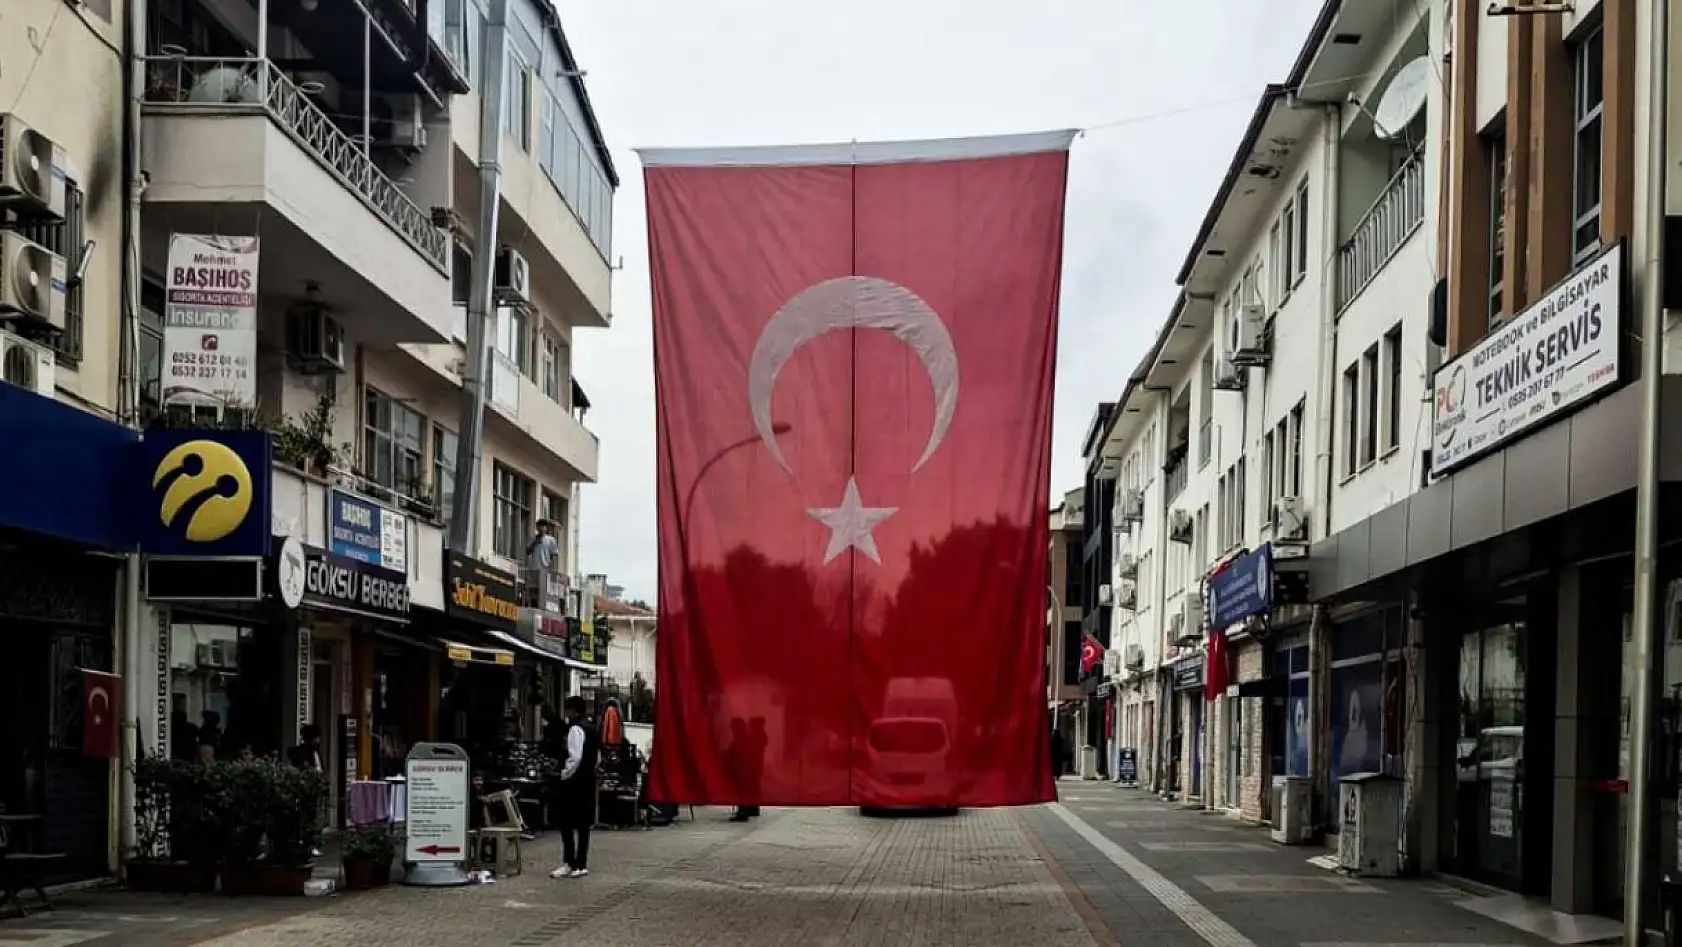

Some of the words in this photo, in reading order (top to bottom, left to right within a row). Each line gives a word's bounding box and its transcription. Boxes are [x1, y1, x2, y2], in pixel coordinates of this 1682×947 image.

[194, 253, 236, 265] Mehmet
[1473, 325, 1524, 367] NOTEBOOK
[1525, 315, 1538, 334] ve
[1541, 264, 1609, 325] BİLGİSAYAR
[1475, 345, 1531, 408] TEKNİK
[1536, 299, 1601, 374] SERVİS
